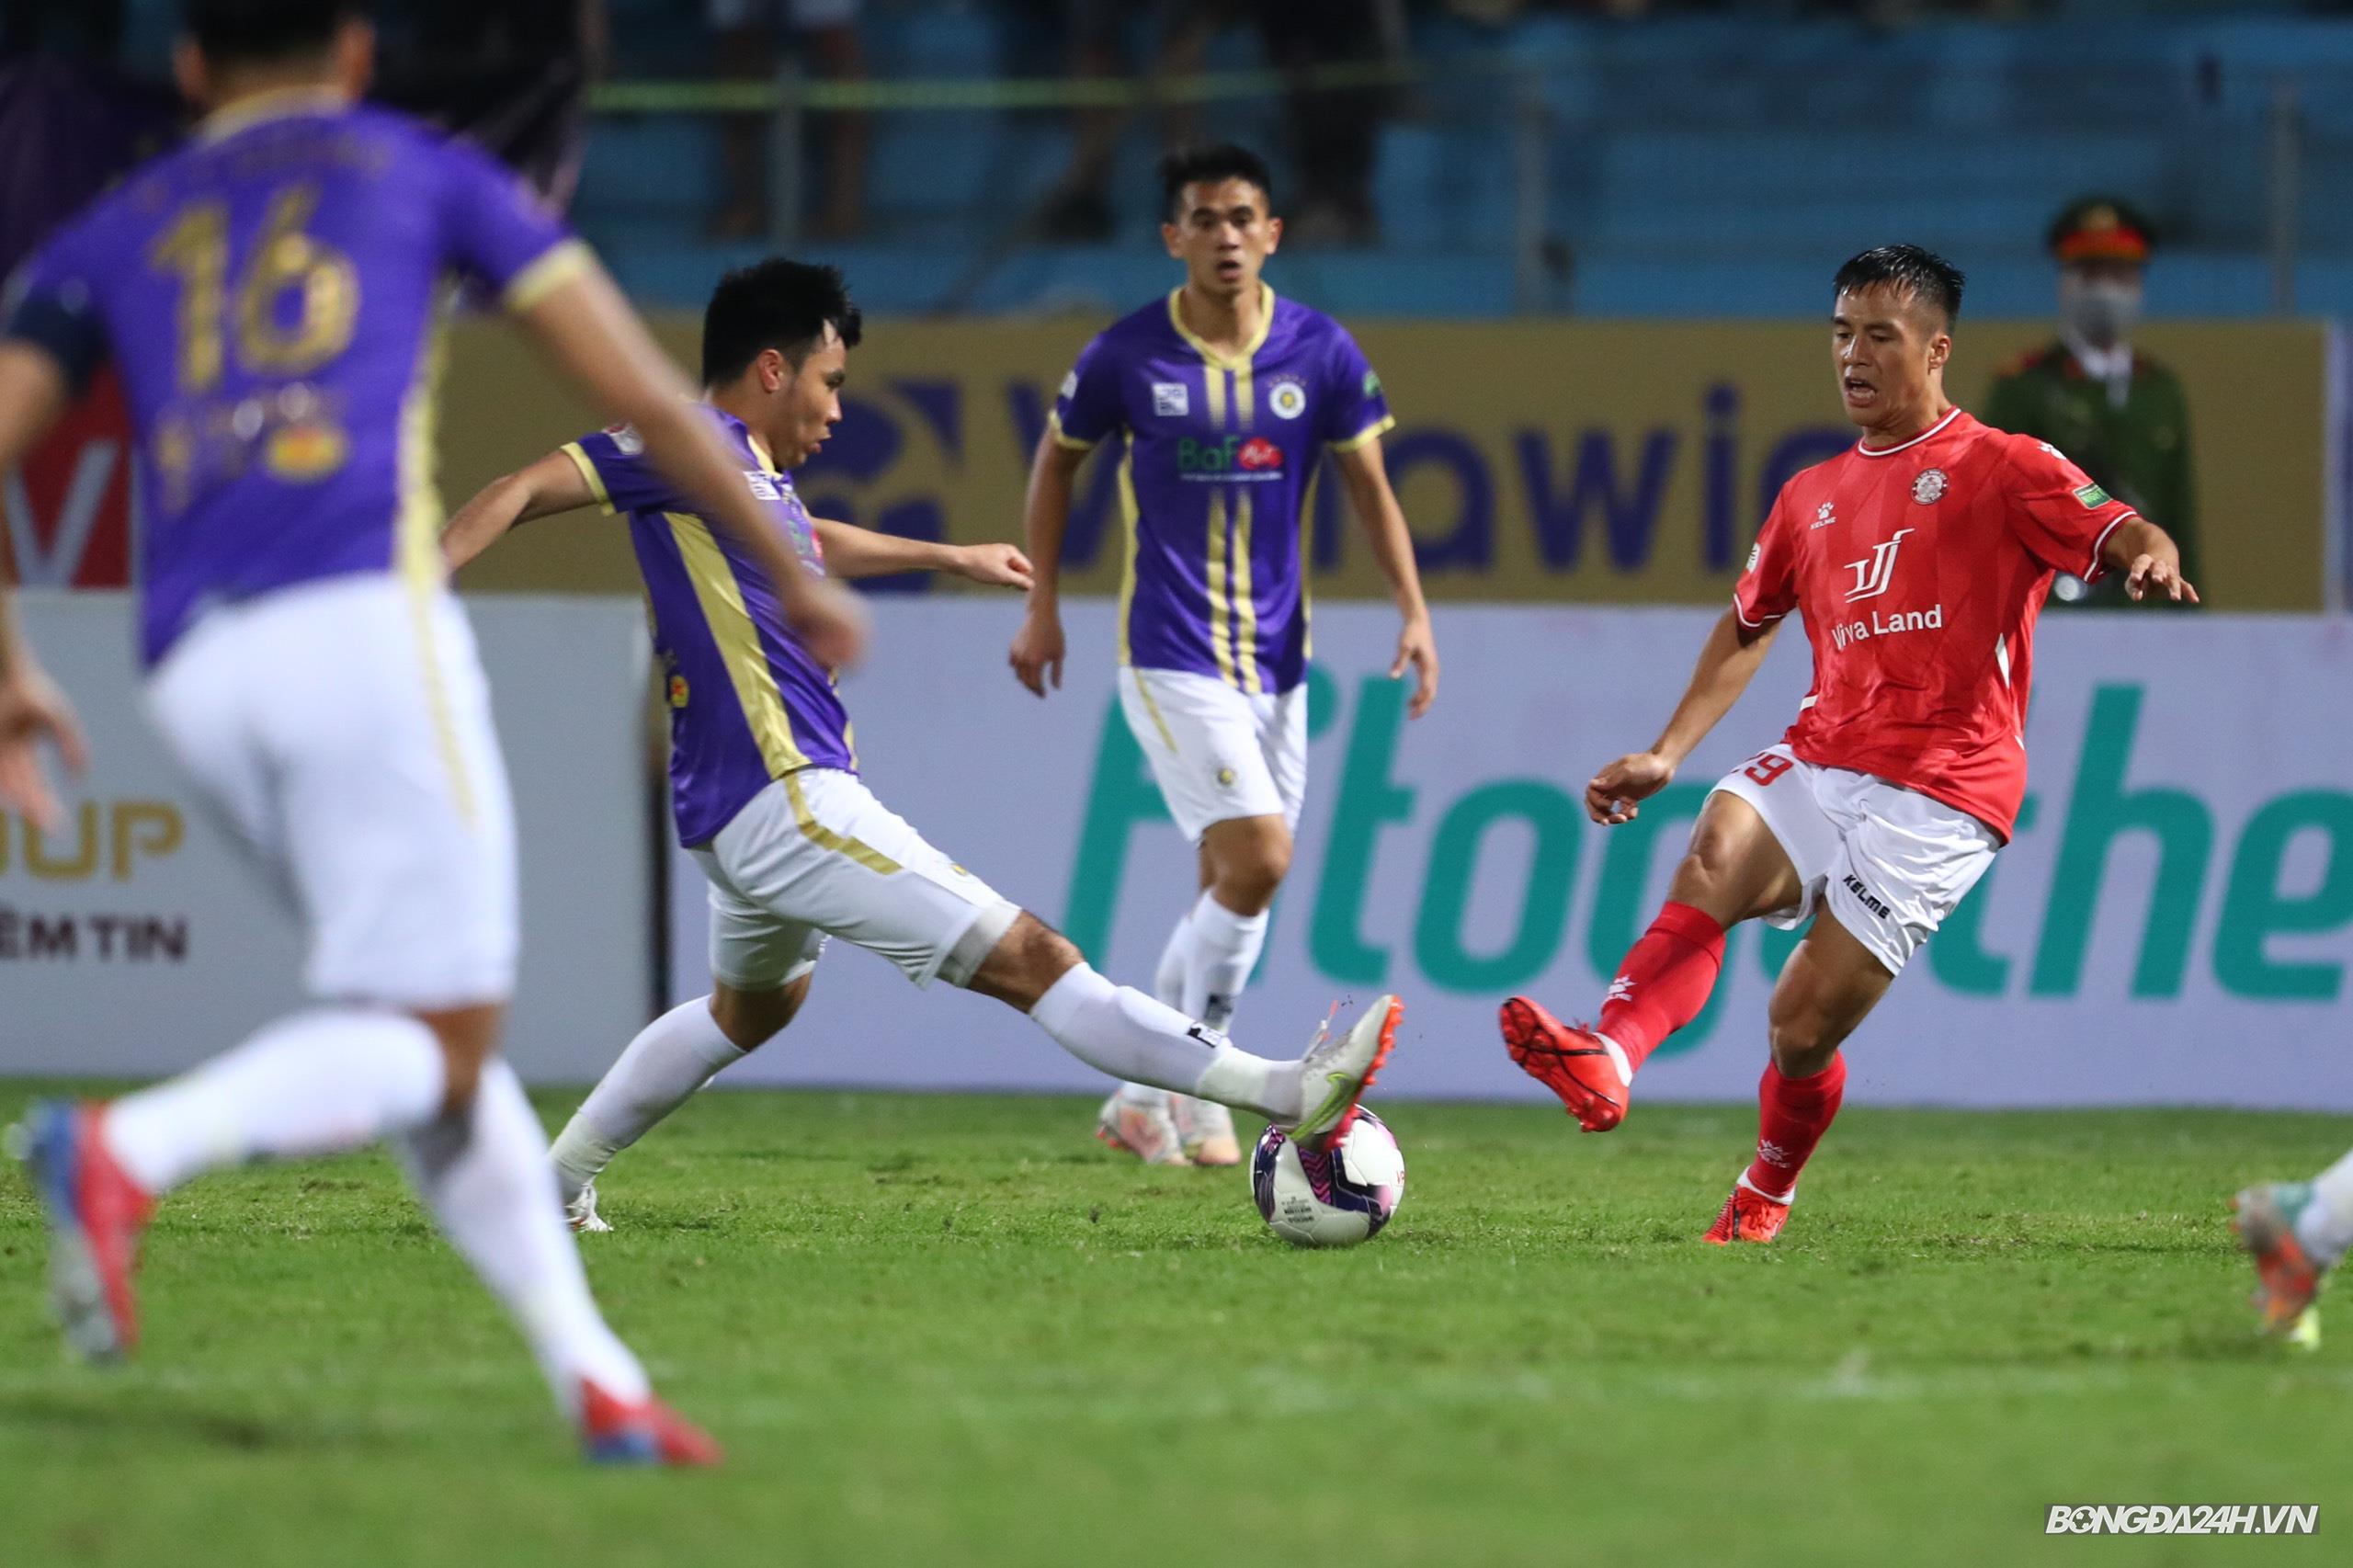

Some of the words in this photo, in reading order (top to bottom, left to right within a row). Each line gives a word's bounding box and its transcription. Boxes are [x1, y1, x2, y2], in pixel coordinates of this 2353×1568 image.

[145, 182, 360, 392] 16
[1832, 620, 1870, 651] Viva
[1871, 603, 1942, 635] Land
[1731, 751, 1794, 787] 9
[0, 798, 187, 884] UP
[1843, 874, 1891, 920] KELME
